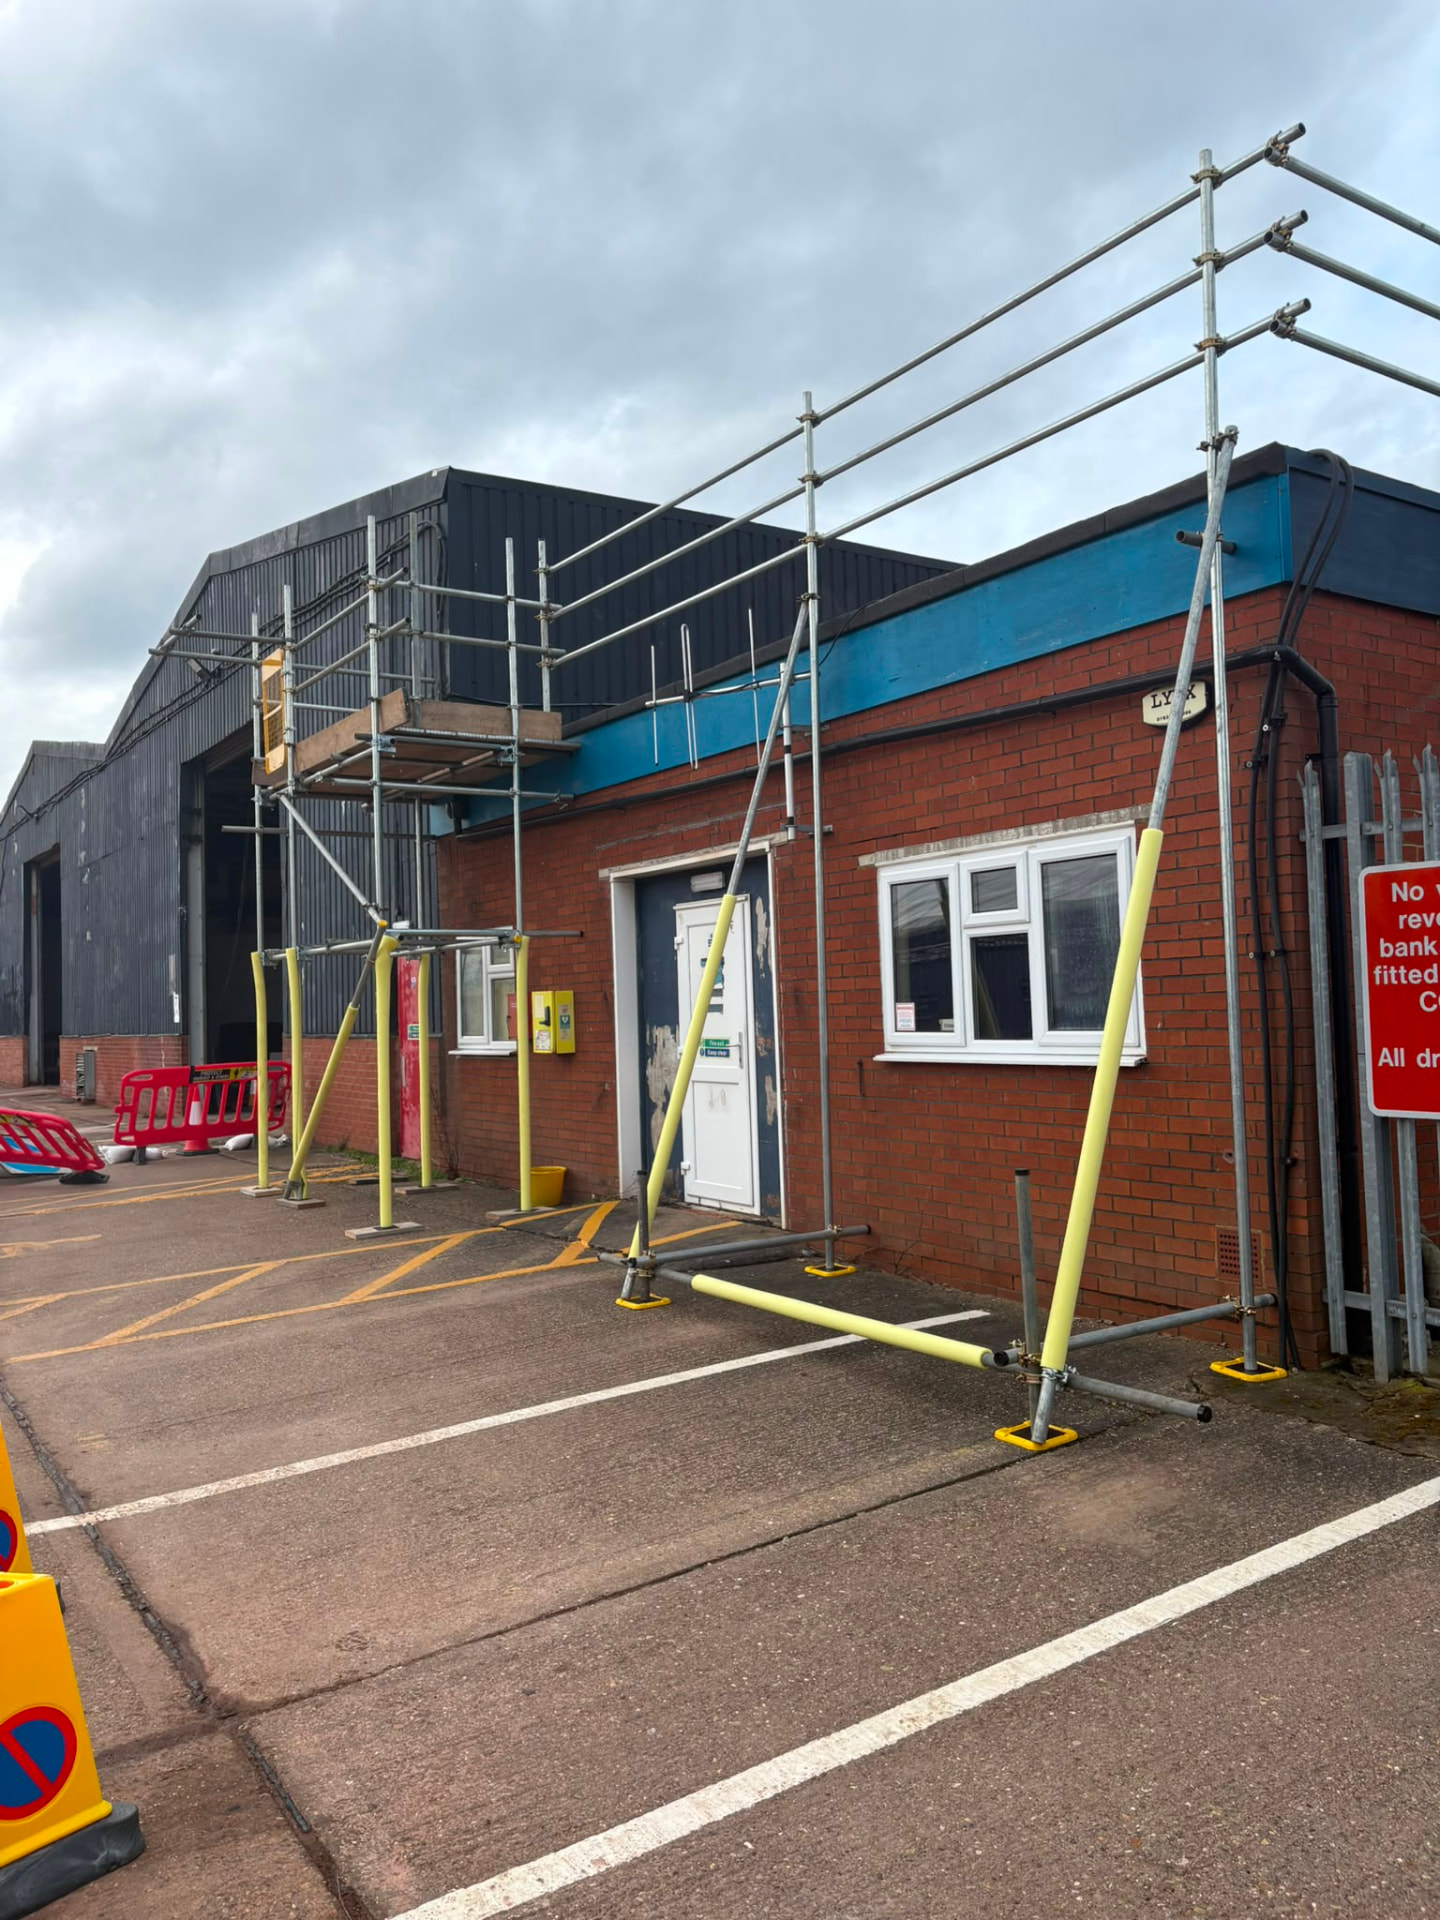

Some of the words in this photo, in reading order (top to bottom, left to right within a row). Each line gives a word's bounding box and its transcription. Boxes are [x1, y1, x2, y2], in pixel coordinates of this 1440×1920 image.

[1150, 684, 1196, 709] LYX
[1391, 881, 1425, 902] No
[1380, 935, 1438, 957] bank
[1373, 963, 1439, 985] fitted
[1419, 991, 1440, 1012] C
[1378, 1047, 1406, 1067] All
